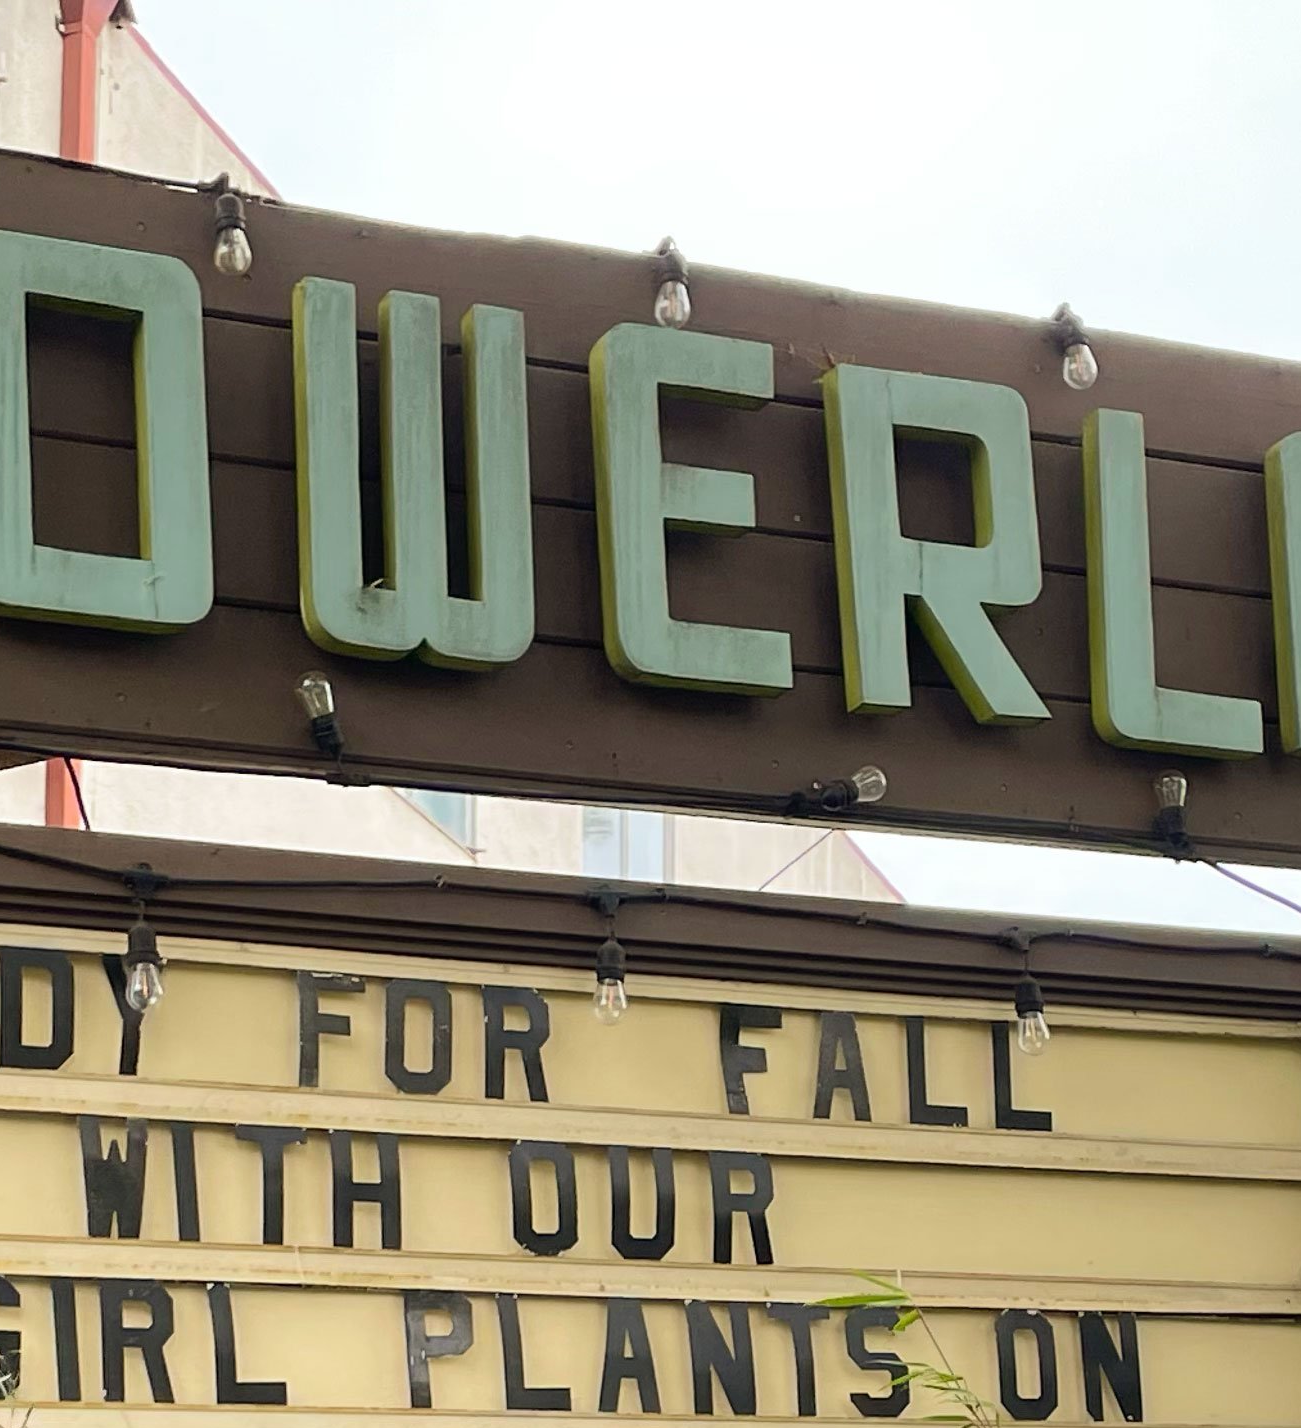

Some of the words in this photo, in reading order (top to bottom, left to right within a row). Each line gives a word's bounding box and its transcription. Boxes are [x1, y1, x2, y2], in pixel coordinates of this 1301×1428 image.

[298, 970, 550, 1104] FOR
[719, 1003, 1053, 1132] FALL
[78, 1116, 402, 1250] WITH
[508, 1140, 774, 1265] OUR
[403, 1289, 911, 1418] PLANTS
[993, 1308, 1144, 1423] ON
